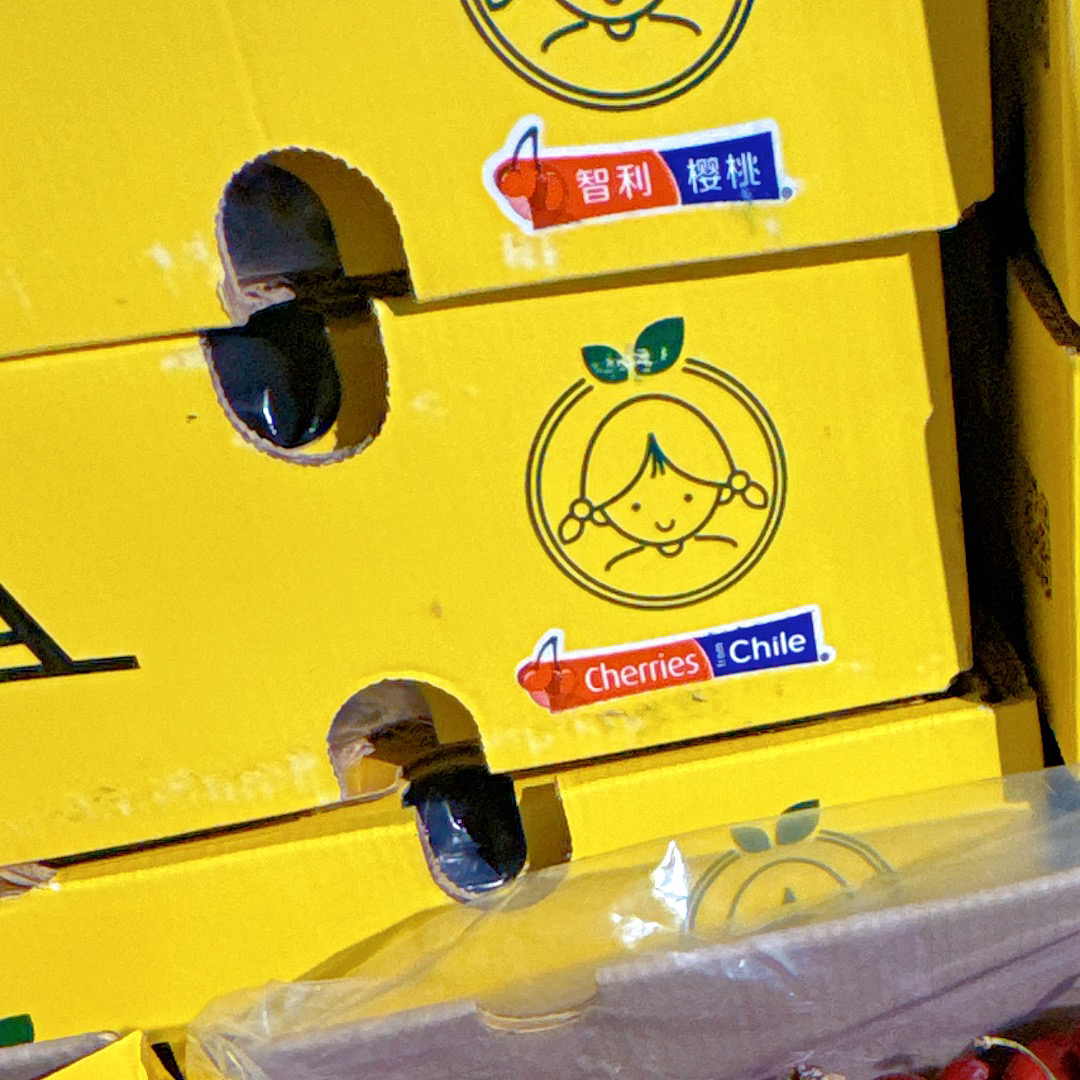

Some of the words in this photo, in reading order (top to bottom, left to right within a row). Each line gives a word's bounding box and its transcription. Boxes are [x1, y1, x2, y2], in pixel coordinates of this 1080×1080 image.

[575, 161, 652, 204] 智利
[686, 152, 761, 194] 樱桃
[585, 652, 699, 693] Cherries
[729, 630, 807, 663] Chile
